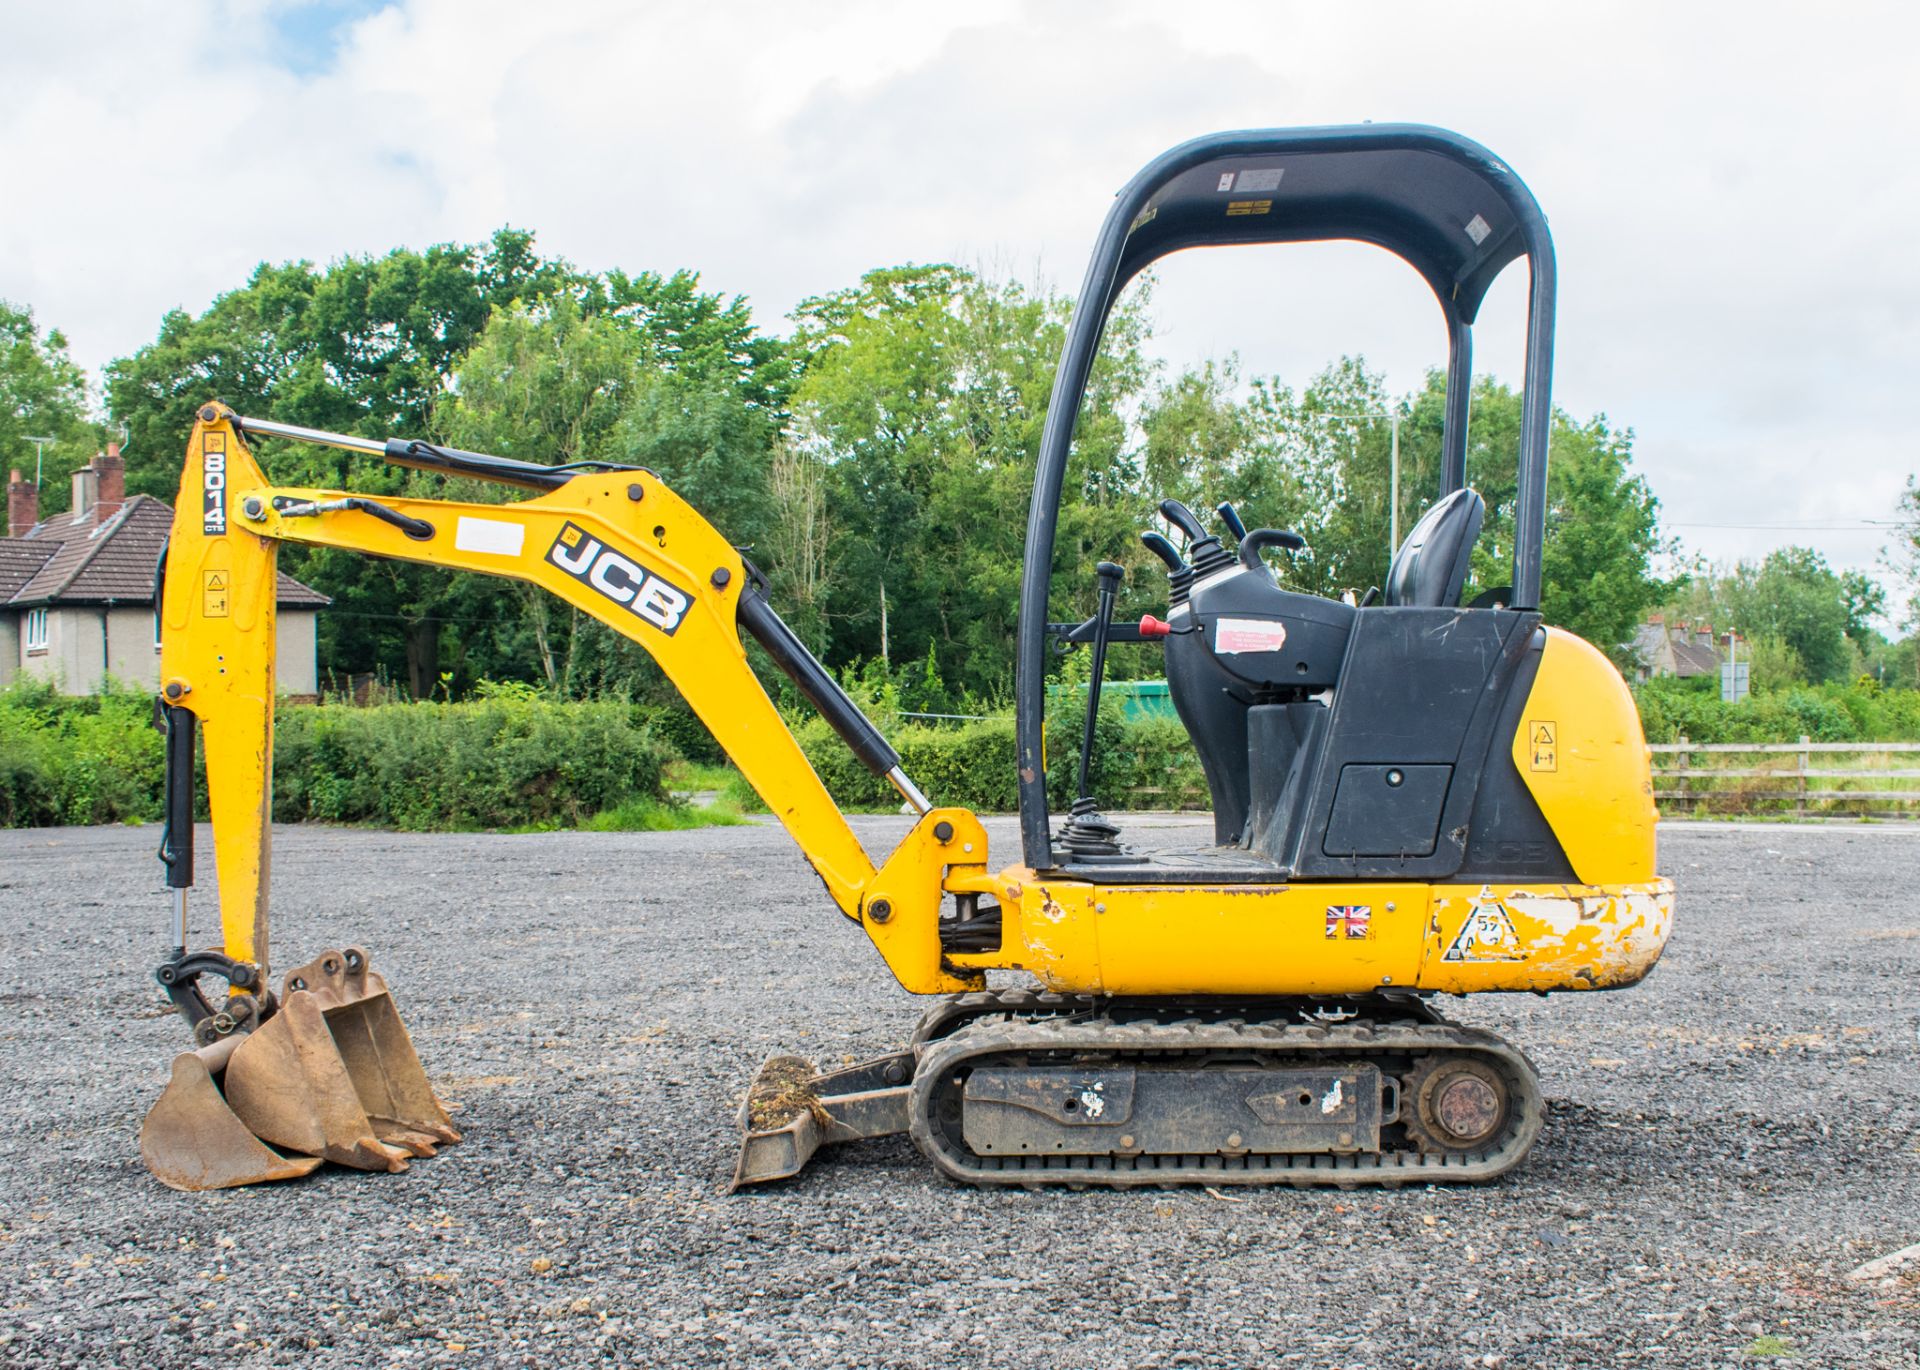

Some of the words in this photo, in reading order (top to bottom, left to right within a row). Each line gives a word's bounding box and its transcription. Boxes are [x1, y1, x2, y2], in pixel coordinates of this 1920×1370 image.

[204, 453, 225, 526] 8014
[552, 539, 687, 630] JCB
[1472, 841, 1549, 864] JCB
